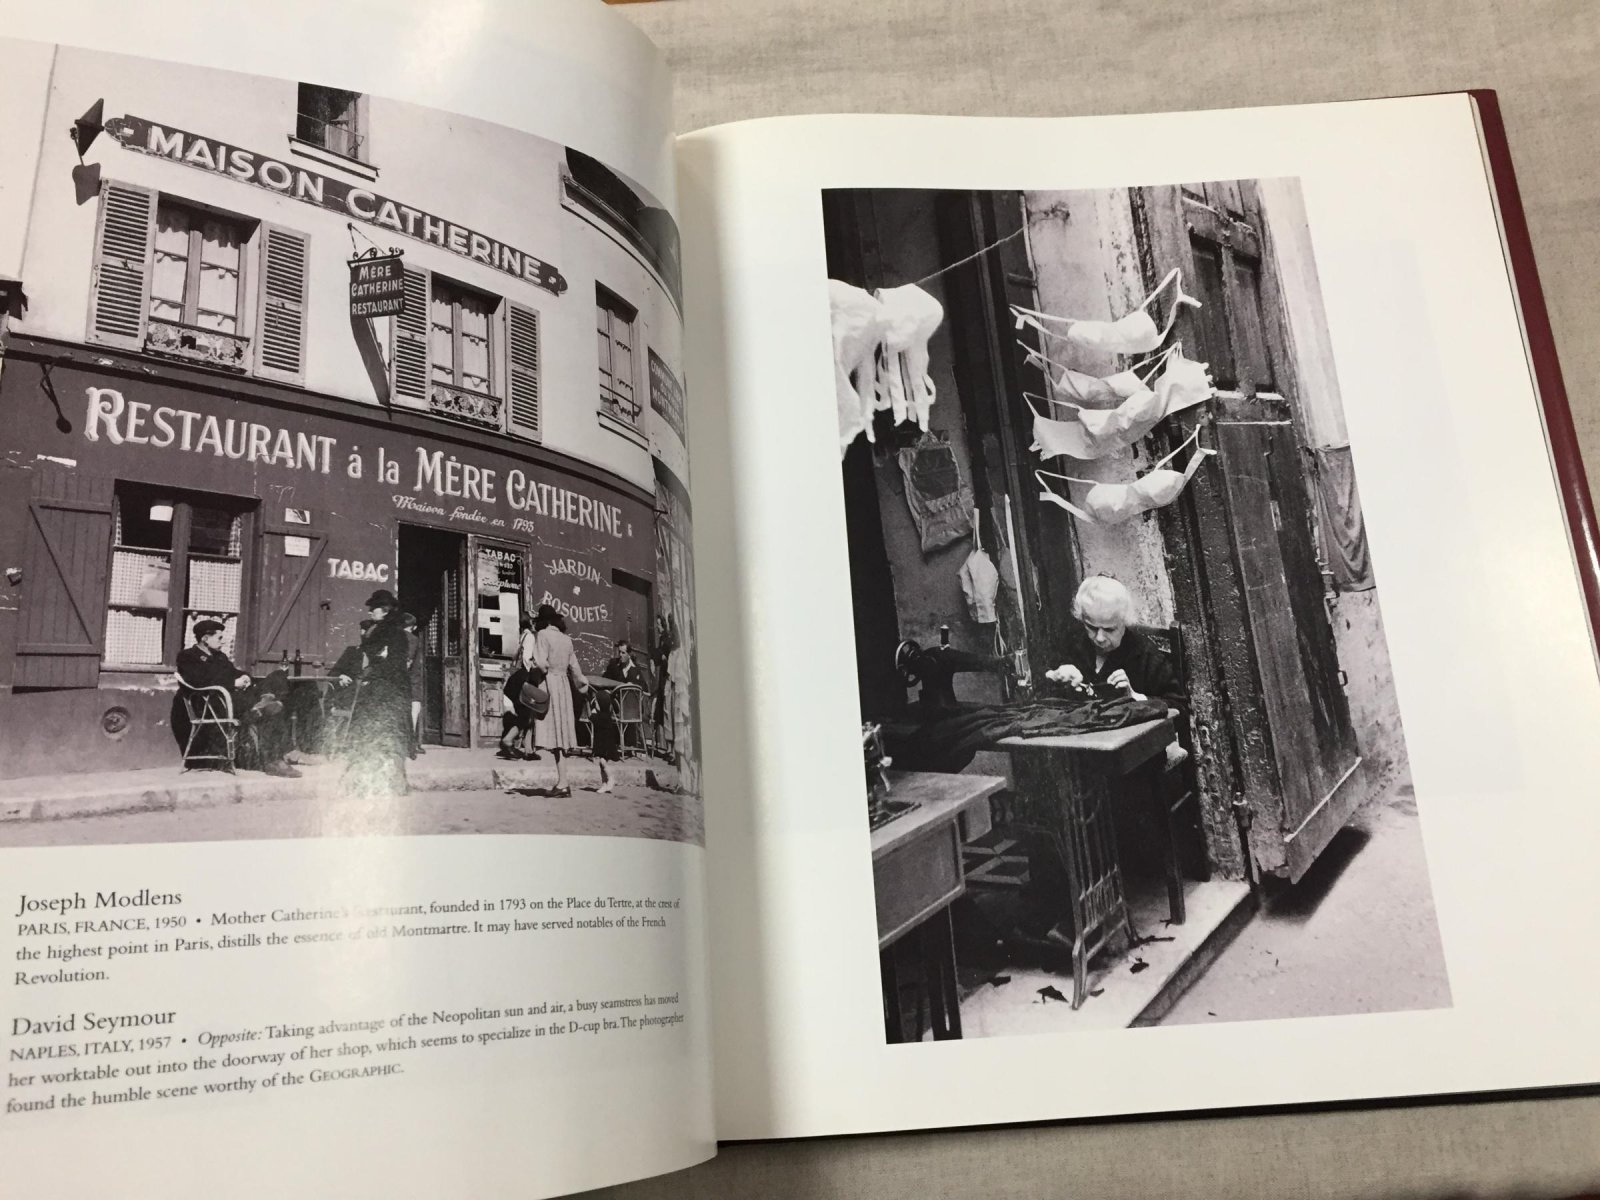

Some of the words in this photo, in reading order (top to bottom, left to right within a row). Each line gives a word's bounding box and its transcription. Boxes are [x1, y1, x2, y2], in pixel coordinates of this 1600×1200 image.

[147, 125, 324, 202] MAISON
[346, 188, 542, 285] CATHERINE
[351, 279, 404, 297] CATHERINE
[352, 298, 404, 315] RESTAURANT
[84, 386, 337, 474] RESTAURANT
[377, 447, 400, 485] la
[506, 469, 623, 539] CATHERINE
[392, 494, 446, 517] Maison
[448, 506, 488, 524] fondée
[491, 517, 506, 528] en
[327, 557, 389, 583] TABAC
[485, 549, 517, 563] TABAC
[549, 558, 601, 585] JARDIN
[15, 892, 87, 917] Joseph
[94, 888, 183, 909] Modlens
[17, 921, 71, 937] PARIS,
[74, 917, 150, 933] FRANCE,
[155, 916, 187, 929] 1950
[210, 911, 266, 926] Mother
[429, 900, 480, 914] founded
[483, 900, 495, 911] in
[499, 898, 527, 911] 1793
[529, 901, 544, 910] on
[547, 897, 564, 909] the
[566, 897, 591, 909] Place
[594, 896, 606, 908] du
[607, 897, 634, 910] Tertre,
[635, 899, 644, 908] at
[645, 897, 656, 908] the
[658, 899, 673, 909] crest
[673, 898, 681, 909] of
[16, 945, 42, 961] the
[47, 942, 104, 962] highest
[107, 941, 148, 960] point
[154, 939, 169, 953] in
[174, 937, 214, 952] Paris,
[217, 933, 262, 949] distills
[266, 932, 289, 945] the
[293, 930, 343, 943] essence
[366, 925, 388, 939] old
[391, 922, 471, 938] Montmartre.
[474, 921, 484, 933] It
[487, 922, 511, 936] may
[514, 918, 539, 932] have
[541, 916, 574, 930] served
[576, 916, 613, 929] notables
[615, 915, 625, 928] of
[627, 916, 639, 927] the
[641, 915, 666, 928] French
[14, 969, 110, 986] Revolution.
[9, 1043, 81, 1062] NAPLES,
[84, 1040, 135, 1056] ITALY,
[139, 1036, 172, 1050] 1957
[198, 1029, 262, 1048] Opposite:
[265, 1024, 315, 1042] Taking
[318, 1017, 385, 1037] advantage
[390, 1013, 407, 1028] of
[408, 1012, 428, 1026] the
[432, 1006, 501, 1025] Neopolitan
[504, 1006, 524, 1018] sun
[527, 1002, 547, 1016] and
[550, 1001, 566, 1015] air,
[568, 1004, 574, 1012] a
[576, 1000, 598, 1014] busy
[600, 996, 642, 1010] seamstress
[644, 994, 656, 1007] has
[657, 992, 679, 1005] moved
[11, 1013, 76, 1036] David
[83, 1010, 177, 1033] Seymour
[8, 1071, 36, 1087] her
[41, 1063, 120, 1083] worktable
[125, 1064, 151, 1077] out
[156, 1059, 187, 1073] into
[193, 1056, 216, 1070] the
[222, 1049, 285, 1068] doorway
[290, 1046, 307, 1061] of
[309, 1045, 332, 1058] her
[337, 1038, 372, 1057] shop,
[376, 1034, 417, 1052] which
[420, 1033, 458, 1048] seems
[461, 1031, 474, 1044] to
[478, 1026, 531, 1046] specialize
[535, 1024, 546, 1037] in
[549, 1022, 565, 1036] the
[568, 1019, 600, 1037] D-cup
[603, 1016, 619, 1031] bra.
[620, 1015, 637, 1029] The
[639, 1011, 684, 1028] photographer
[6, 1095, 55, 1114] found
[61, 1091, 86, 1108] the
[92, 1085, 152, 1105] humble
[156, 1083, 198, 1099] scene
[203, 1075, 257, 1094] worthy
[262, 1072, 279, 1087] of
[281, 1071, 305, 1085] the
[309, 1063, 405, 1083] GEOGRAPHIC.
